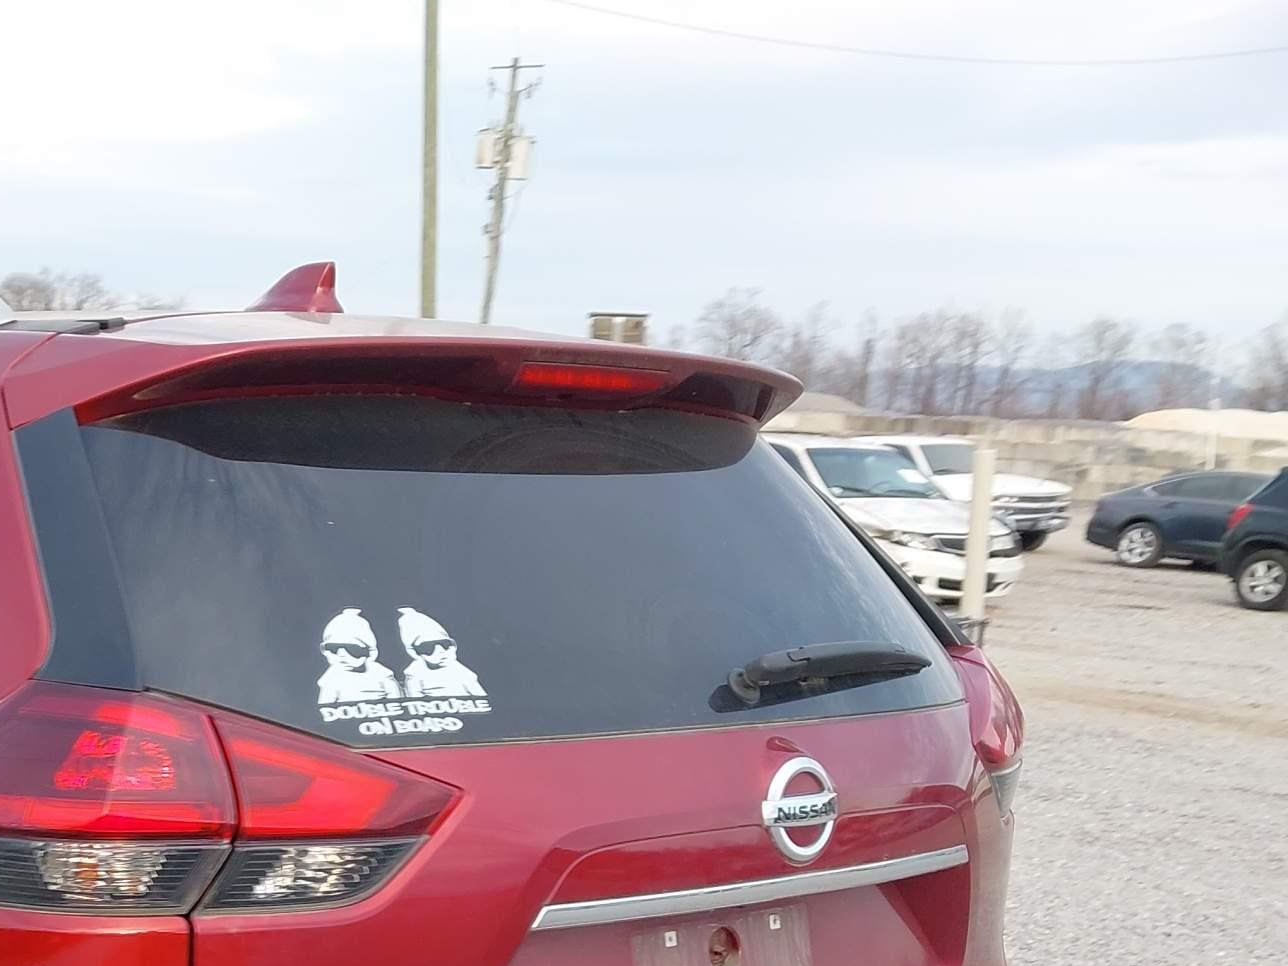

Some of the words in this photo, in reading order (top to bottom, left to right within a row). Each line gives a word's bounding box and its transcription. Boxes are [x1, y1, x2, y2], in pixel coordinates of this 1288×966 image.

[319, 703, 404, 722] DOUBLE
[403, 698, 492, 716] TROUBLE
[358, 716, 394, 735] ON
[394, 716, 464, 734] BOARD
[775, 799, 836, 822] NISSAN
